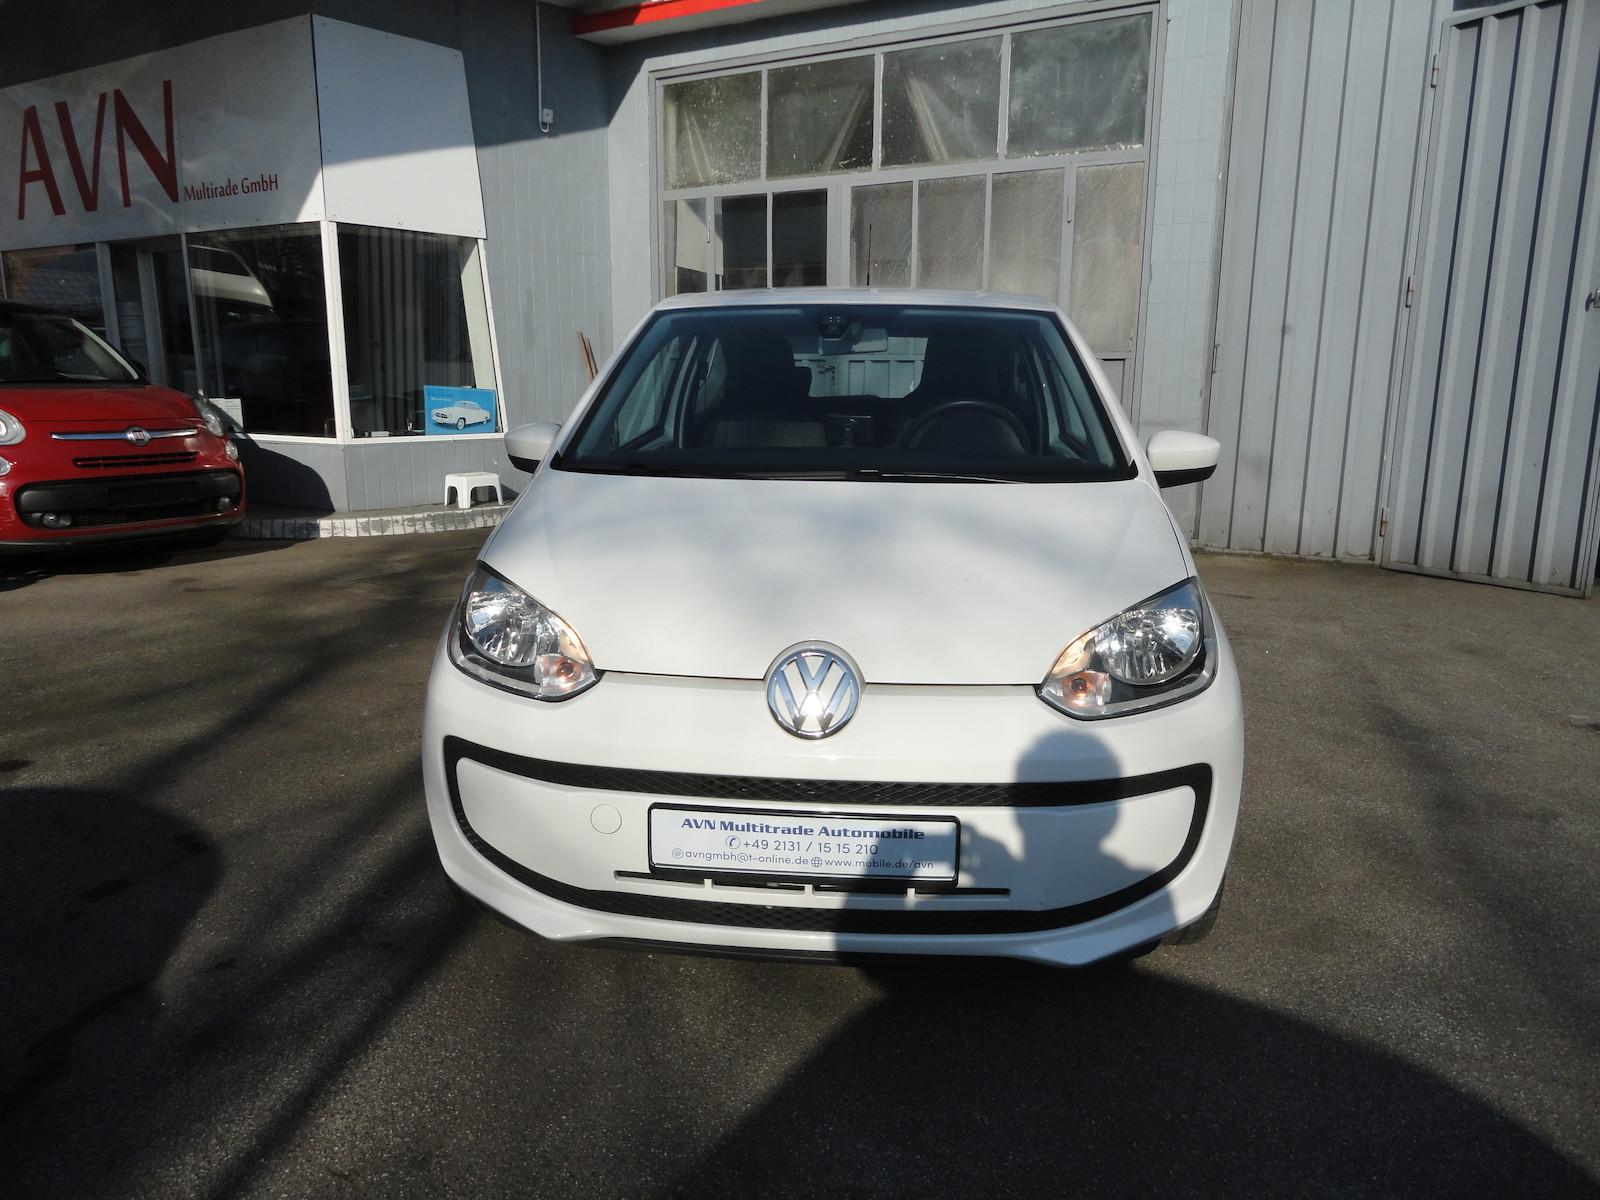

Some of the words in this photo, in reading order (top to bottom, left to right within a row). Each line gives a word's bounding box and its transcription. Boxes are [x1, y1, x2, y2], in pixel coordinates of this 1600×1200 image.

[18, 80, 179, 220] AVN
[241, 174, 279, 195] GmbH
[681, 818, 716, 830] AVN
[720, 820, 814, 836] Multitrade
[818, 826, 925, 840] Automobile
[743, 839, 769, 850] +49
[774, 840, 801, 852] 2131
[818, 842, 832, 853] 15
[837, 843, 850, 854] 15
[855, 844, 879, 855] 210
[824, 859, 934, 870] www.mobile.de/avn
